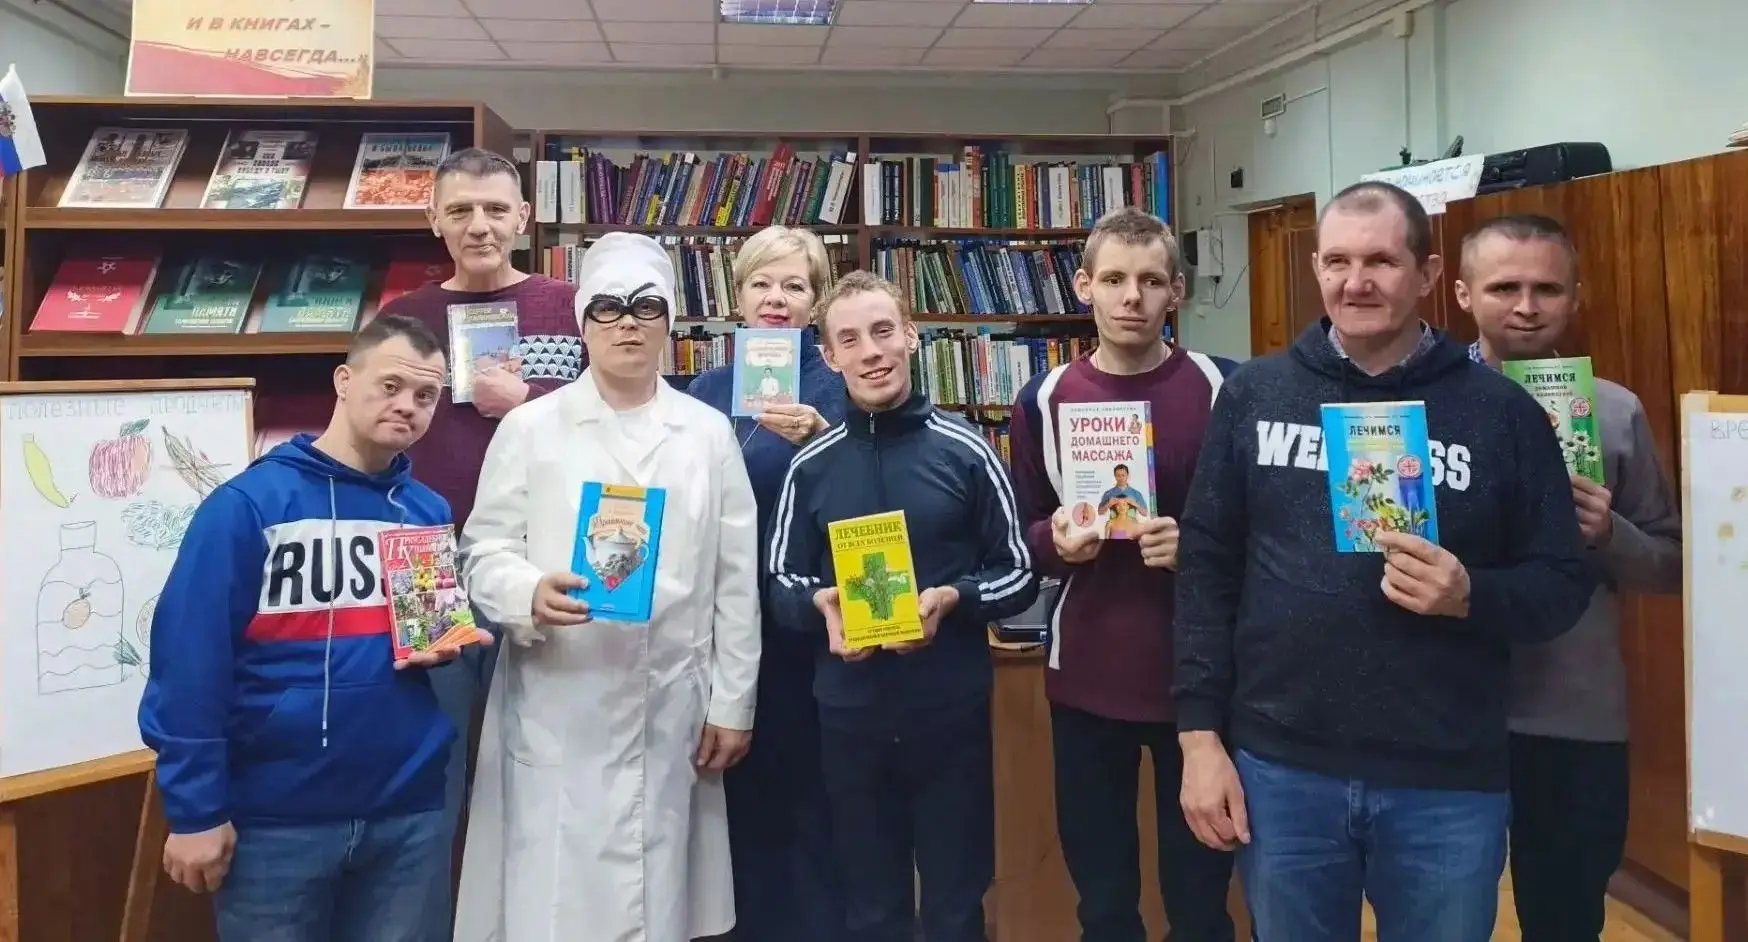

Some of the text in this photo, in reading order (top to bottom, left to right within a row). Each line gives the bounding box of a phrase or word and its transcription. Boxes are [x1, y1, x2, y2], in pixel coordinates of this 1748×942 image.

[185, 17, 201, 31] И
[208, 17, 224, 31] В
[229, 17, 317, 31] КНИГАХ
[1524, 372, 1577, 384] ЛЕЧИМСЯ
[1070, 416, 1126, 433] УРОКИ
[1349, 424, 1401, 436] ЛЕЧИМСЯ
[1070, 435, 1140, 447] ДОМАШНЕГО
[1071, 449, 1134, 462] МАССАЖА
[834, 520, 903, 541] ЛЕЧЕБНИК
[268, 536, 387, 607] RUS
